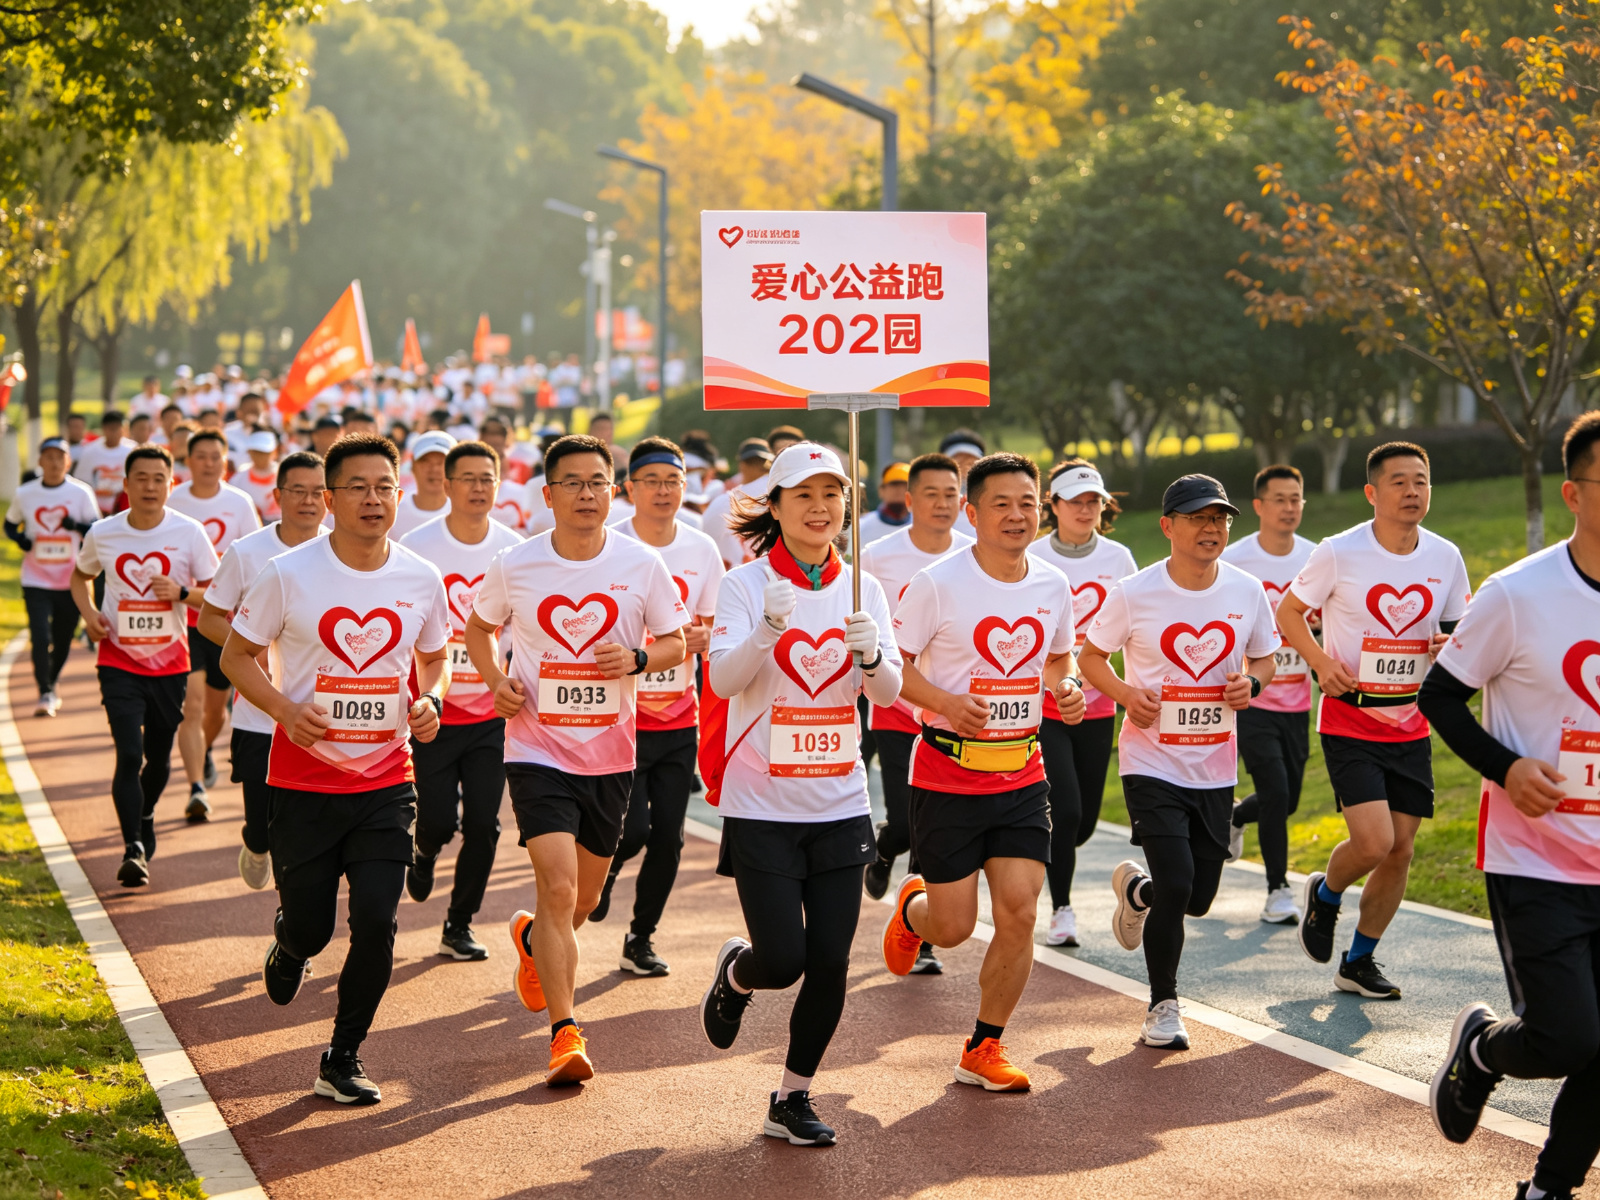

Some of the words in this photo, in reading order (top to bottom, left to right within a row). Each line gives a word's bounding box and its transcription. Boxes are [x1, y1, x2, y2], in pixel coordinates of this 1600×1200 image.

[750, 262, 944, 301] 爱心公益跑
[778, 313, 921, 355] 202园
